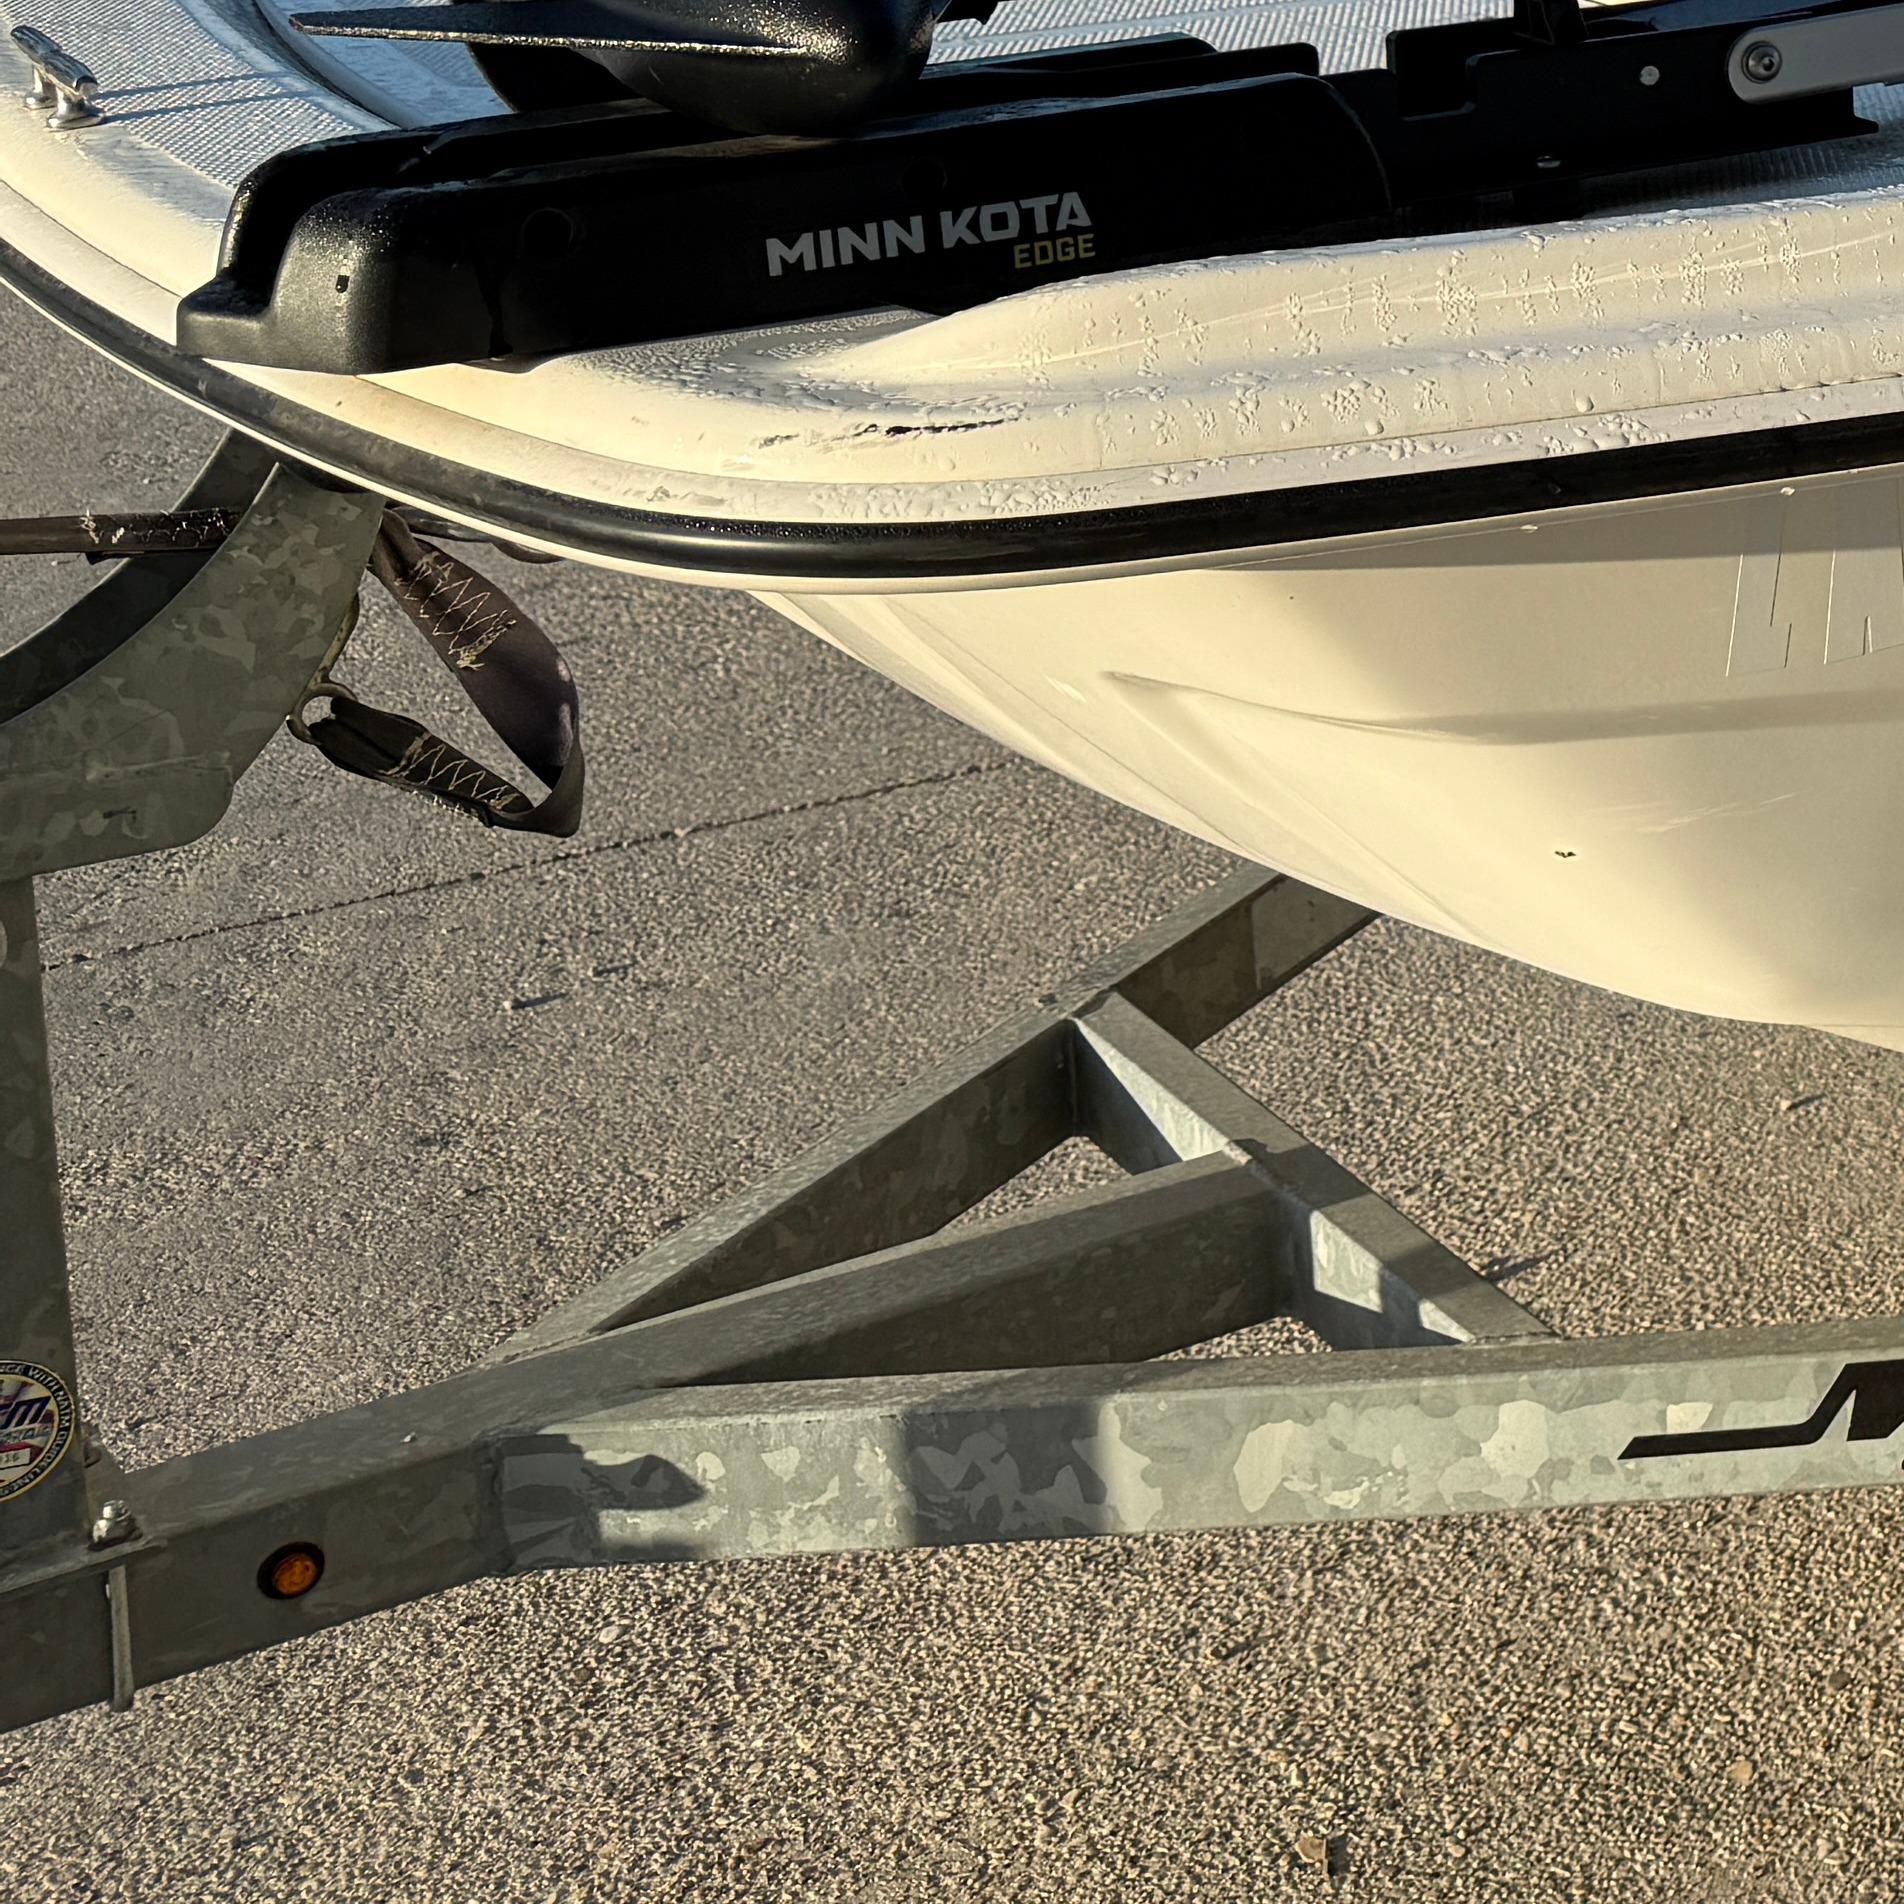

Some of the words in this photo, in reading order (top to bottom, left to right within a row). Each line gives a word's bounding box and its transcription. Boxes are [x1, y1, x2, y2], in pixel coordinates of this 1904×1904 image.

[766, 215, 925, 277] MINN
[940, 191, 1092, 250] KOTA
[1014, 233, 1096, 269] EDGE
